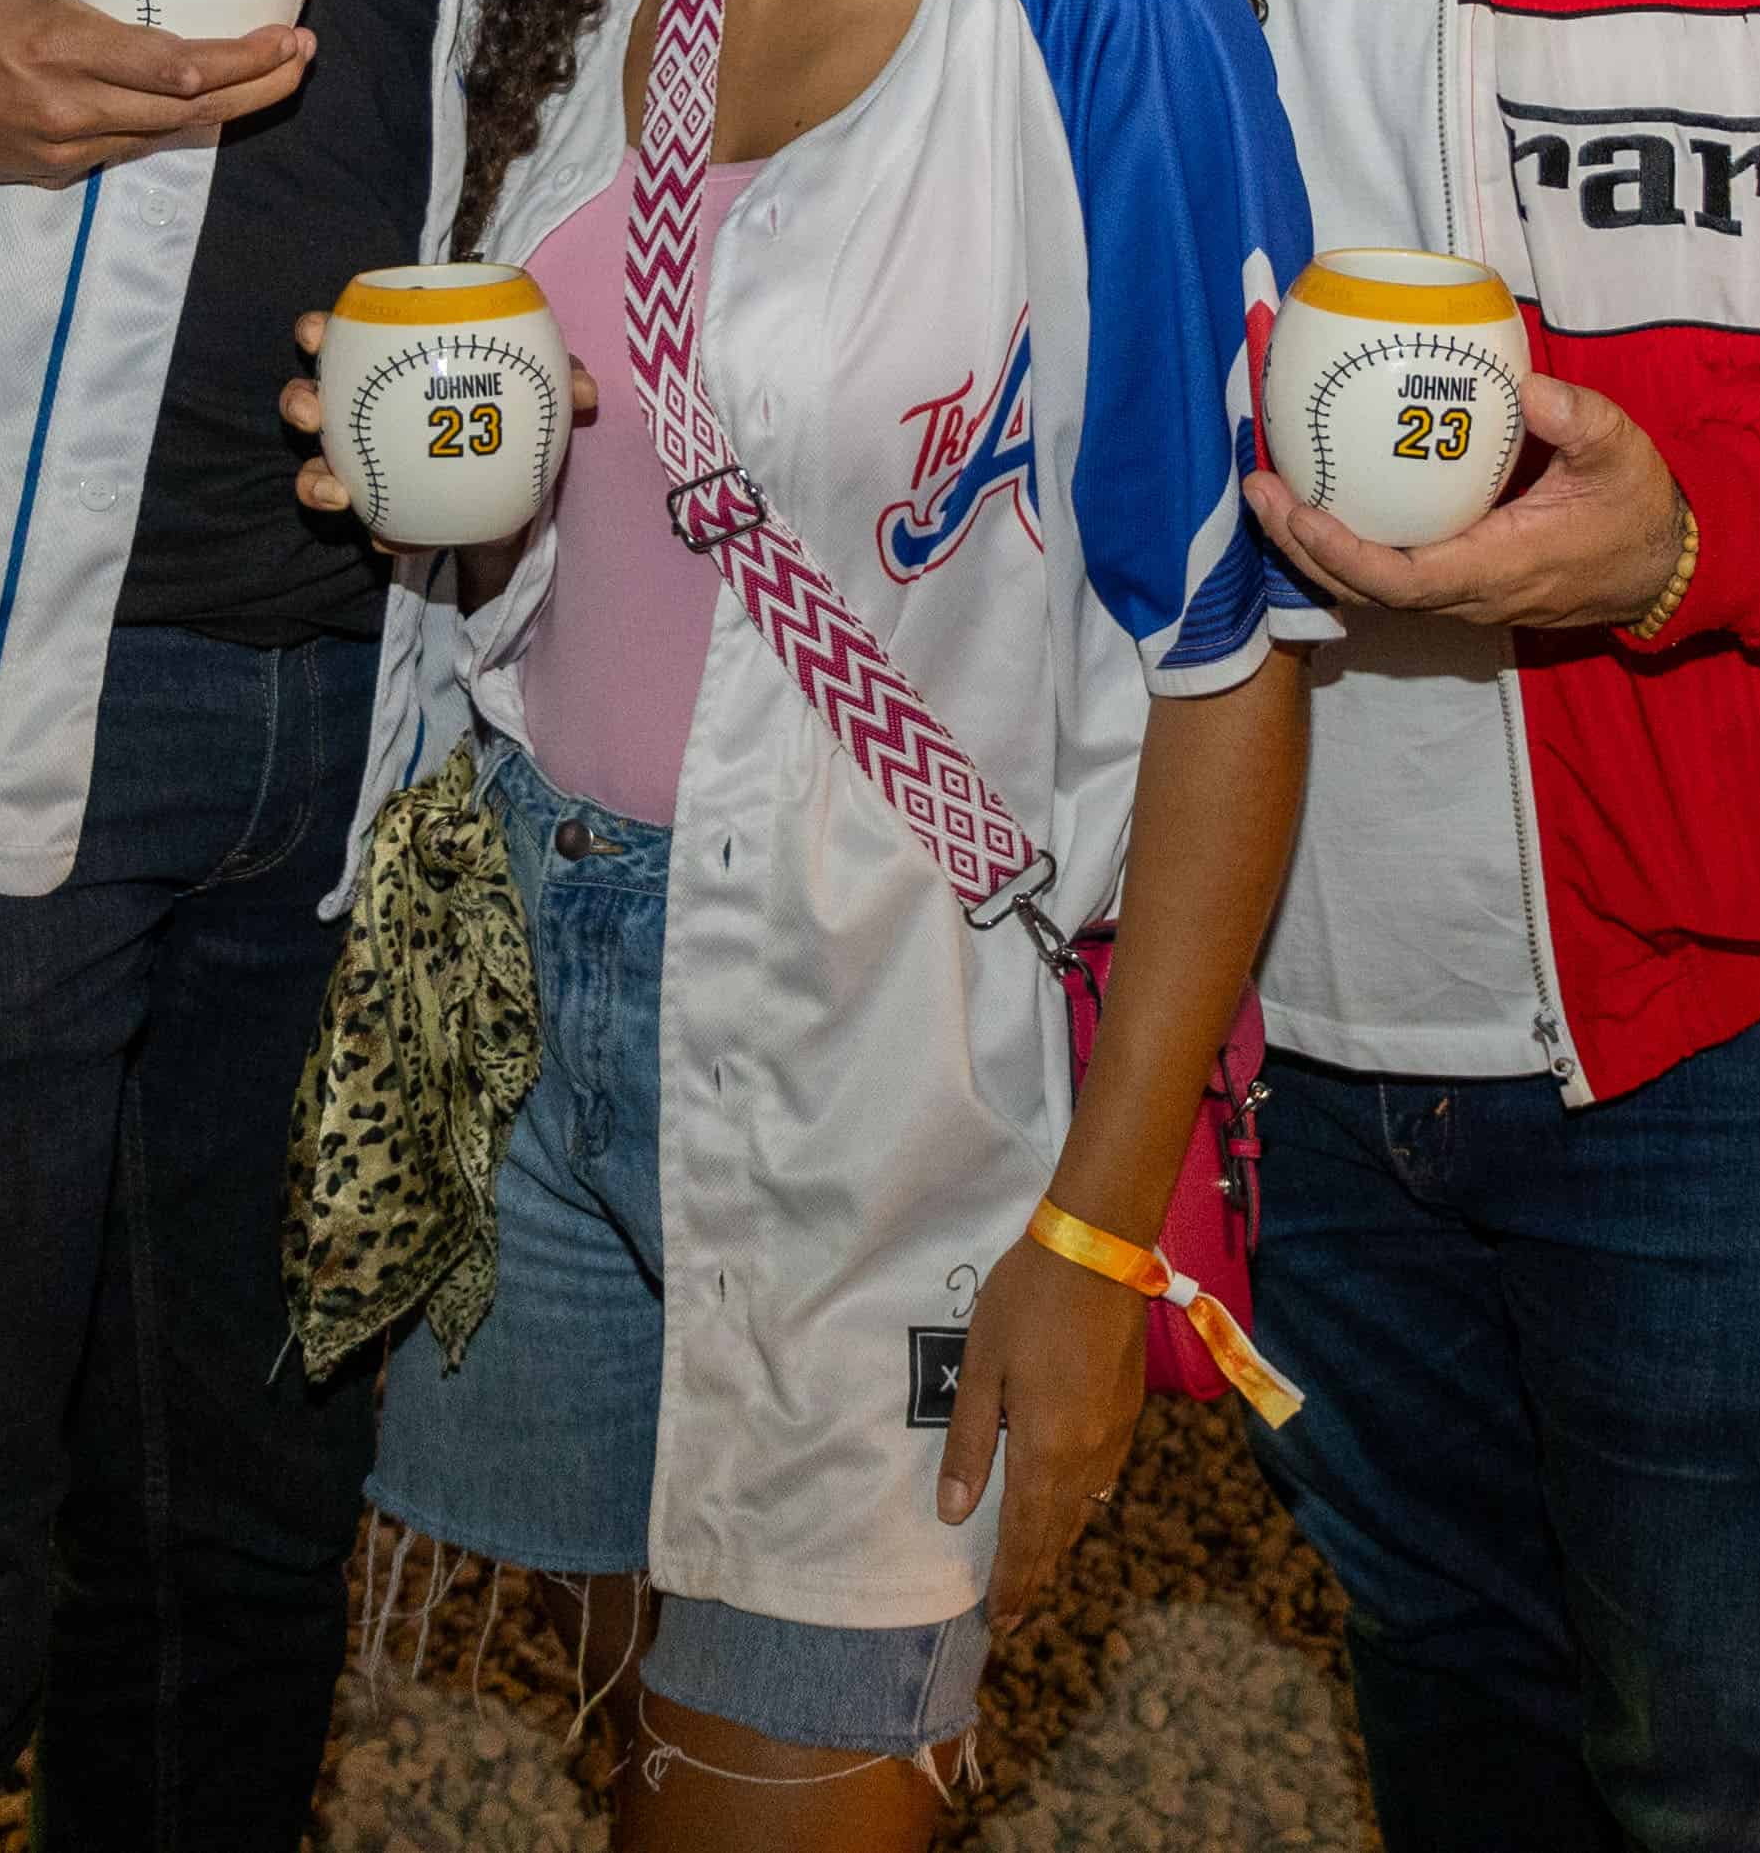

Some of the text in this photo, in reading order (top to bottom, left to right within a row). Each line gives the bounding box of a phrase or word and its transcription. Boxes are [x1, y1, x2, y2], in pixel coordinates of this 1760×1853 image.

[424, 372, 504, 401] JOHNNIE
[1398, 374, 1478, 403] JOHNNIE
[428, 403, 503, 458] 23
[1393, 406, 1472, 461] 23
